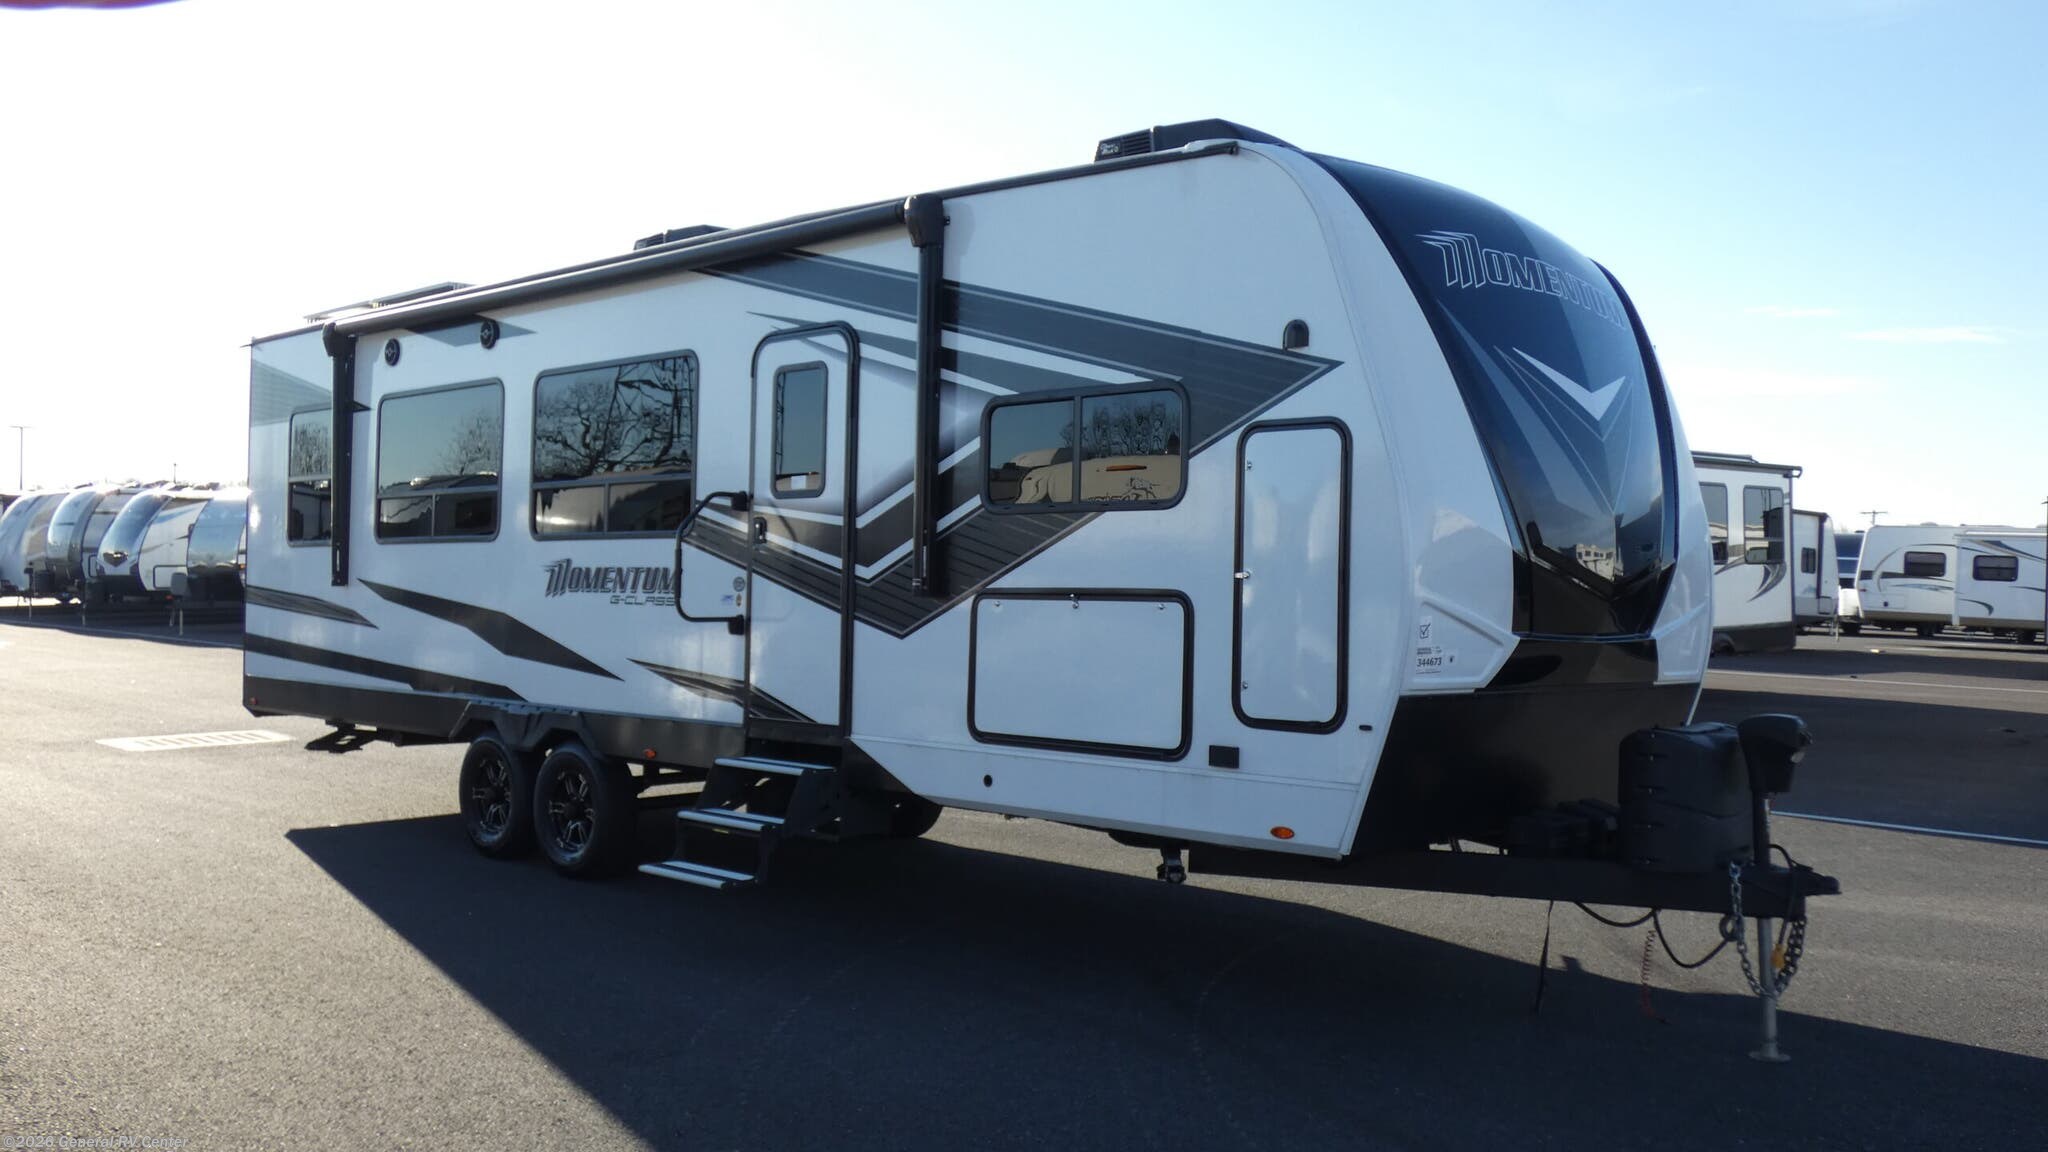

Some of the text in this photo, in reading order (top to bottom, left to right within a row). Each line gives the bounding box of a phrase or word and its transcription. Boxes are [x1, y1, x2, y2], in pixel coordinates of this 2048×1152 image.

[1415, 230, 1627, 330] MOMENTUM
[544, 558, 676, 598] MOMENTUM
[609, 595, 676, 607] G-CLASS
[1417, 657, 1442, 667] 344673
